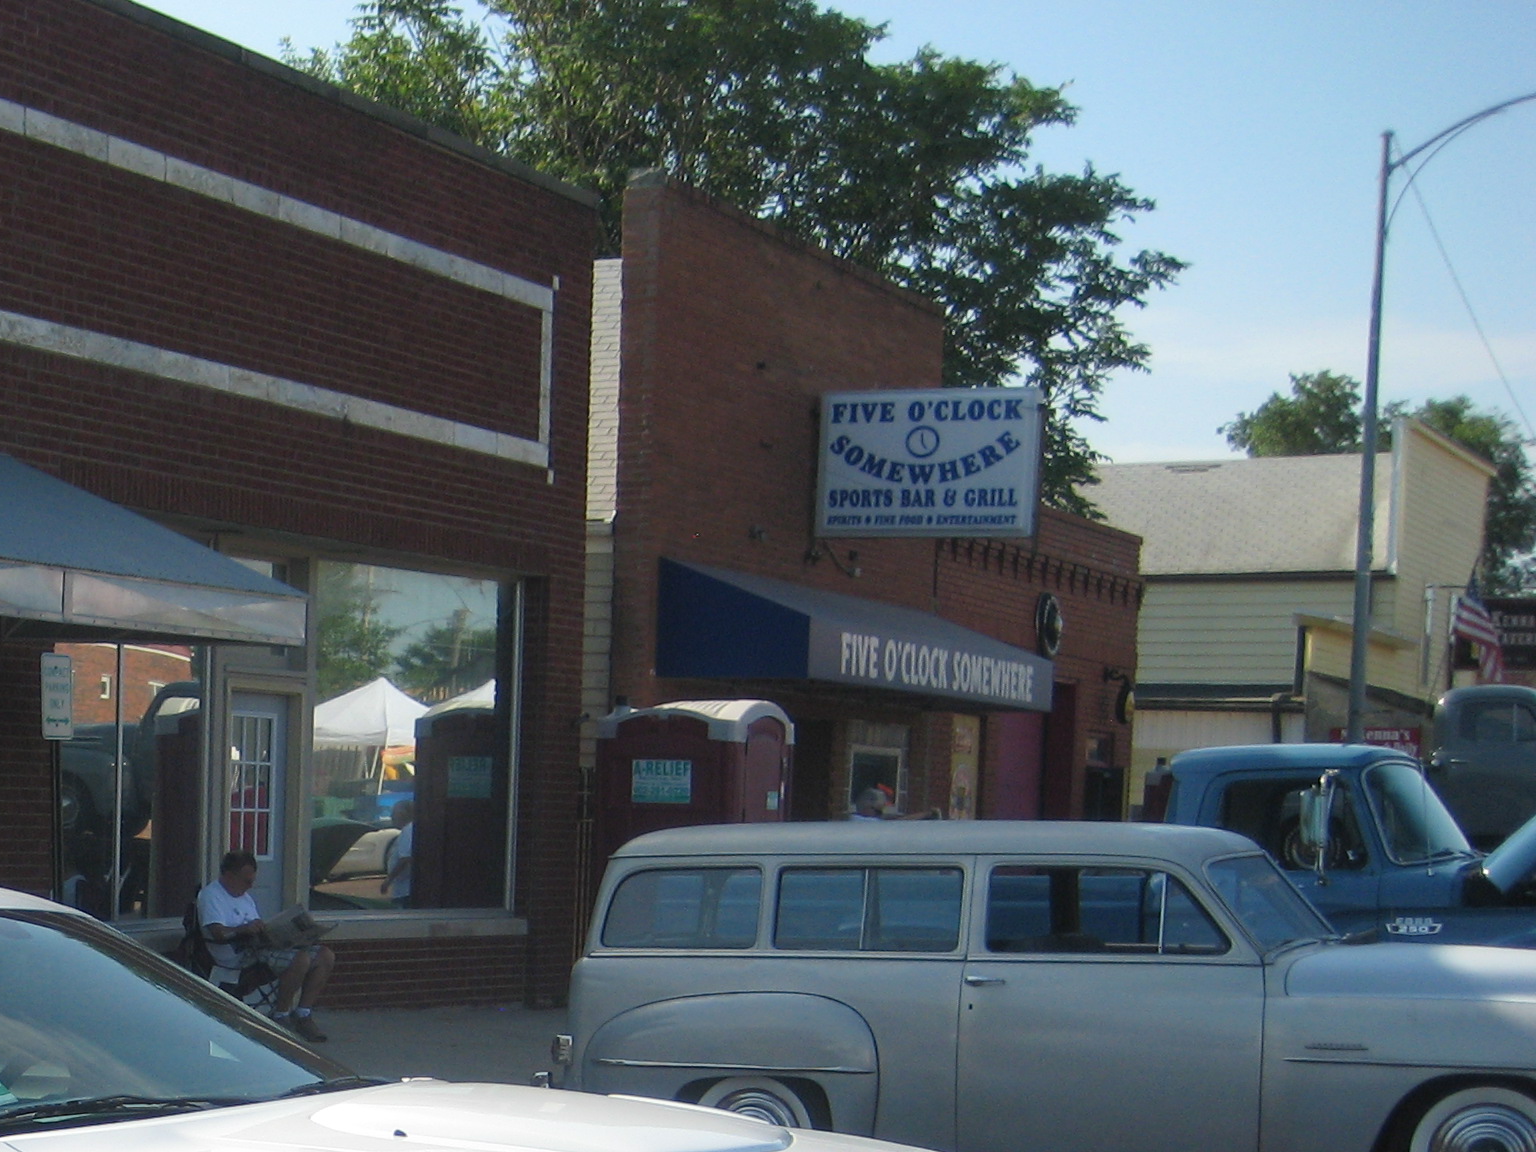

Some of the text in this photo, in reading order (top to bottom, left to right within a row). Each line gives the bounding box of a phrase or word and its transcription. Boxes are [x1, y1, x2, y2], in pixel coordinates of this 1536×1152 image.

[831, 399, 1023, 423] FIVE O'CLOCK
[829, 430, 1022, 485] SOMEWHERE
[828, 487, 1018, 508] SPORTS BAR & GRILL
[899, 514, 923, 525] FOOD
[936, 514, 1017, 525] ENTERTAINMENT
[840, 632, 1034, 702] FIVE O'CLOCK SOMEWHERE
